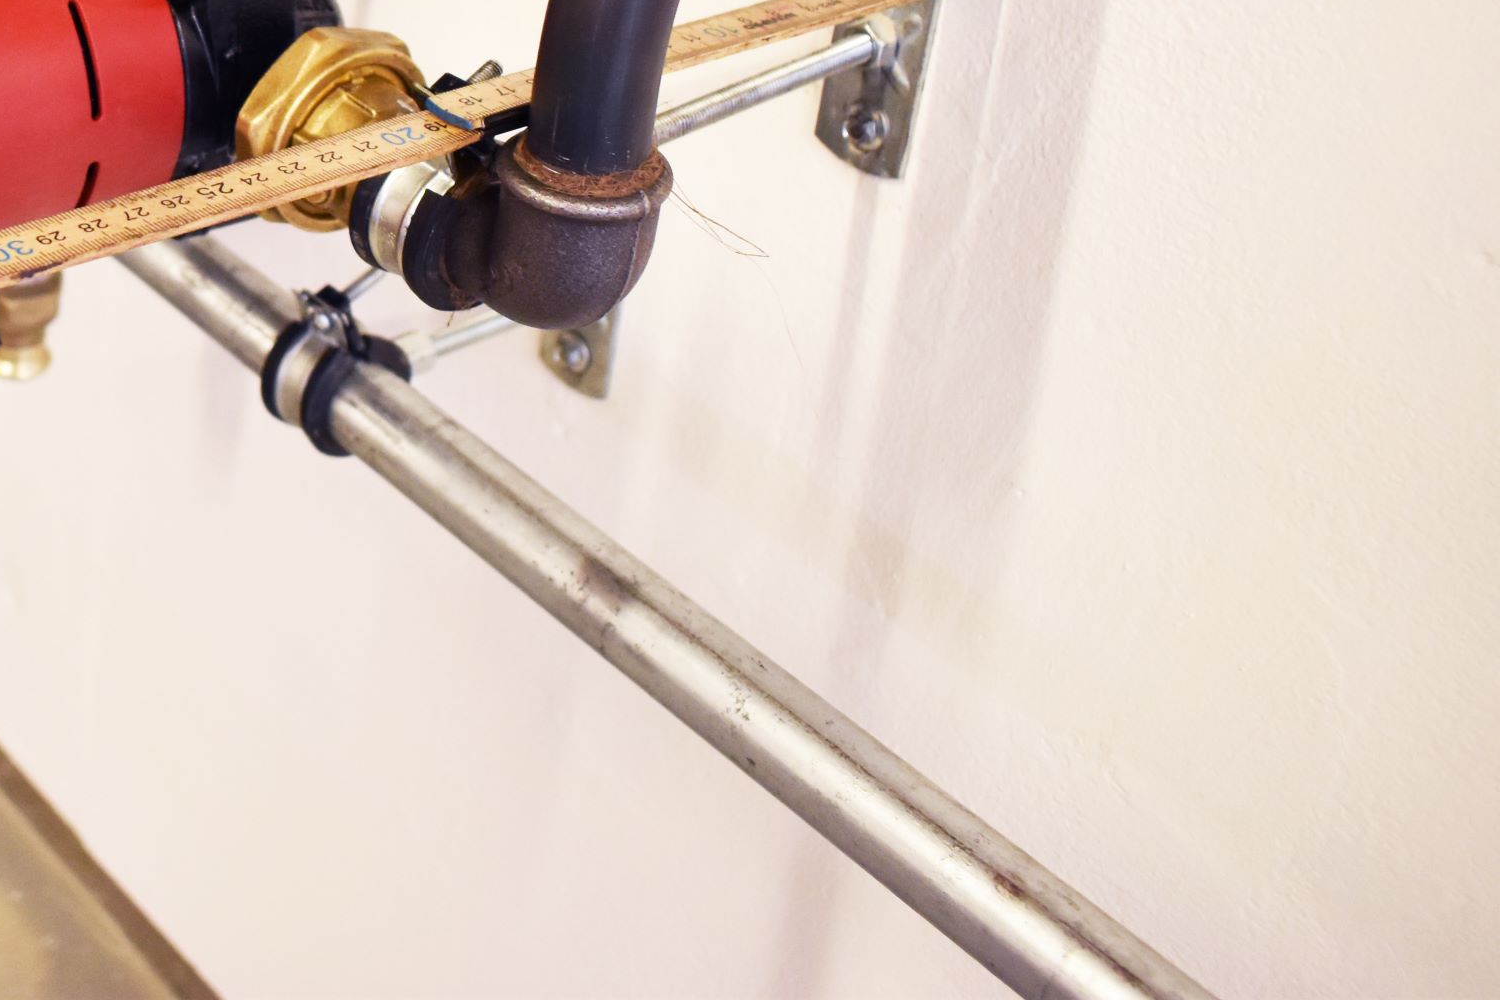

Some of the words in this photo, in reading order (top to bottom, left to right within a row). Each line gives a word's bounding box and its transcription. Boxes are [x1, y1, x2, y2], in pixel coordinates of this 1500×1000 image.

[496, 85, 516, 96] 17
[458, 95, 484, 107] 18
[424, 120, 448, 132] 19
[381, 126, 424, 146] 20
[352, 140, 378, 153] 21
[315, 151, 343, 164] 22
[277, 161, 307, 175] 23
[239, 172, 268, 186] 24
[195, 180, 234, 200] 25
[160, 194, 191, 211] 26
[125, 205, 150, 223] 27
[78, 218, 109, 234] 28
[36, 229, 67, 246] 29
